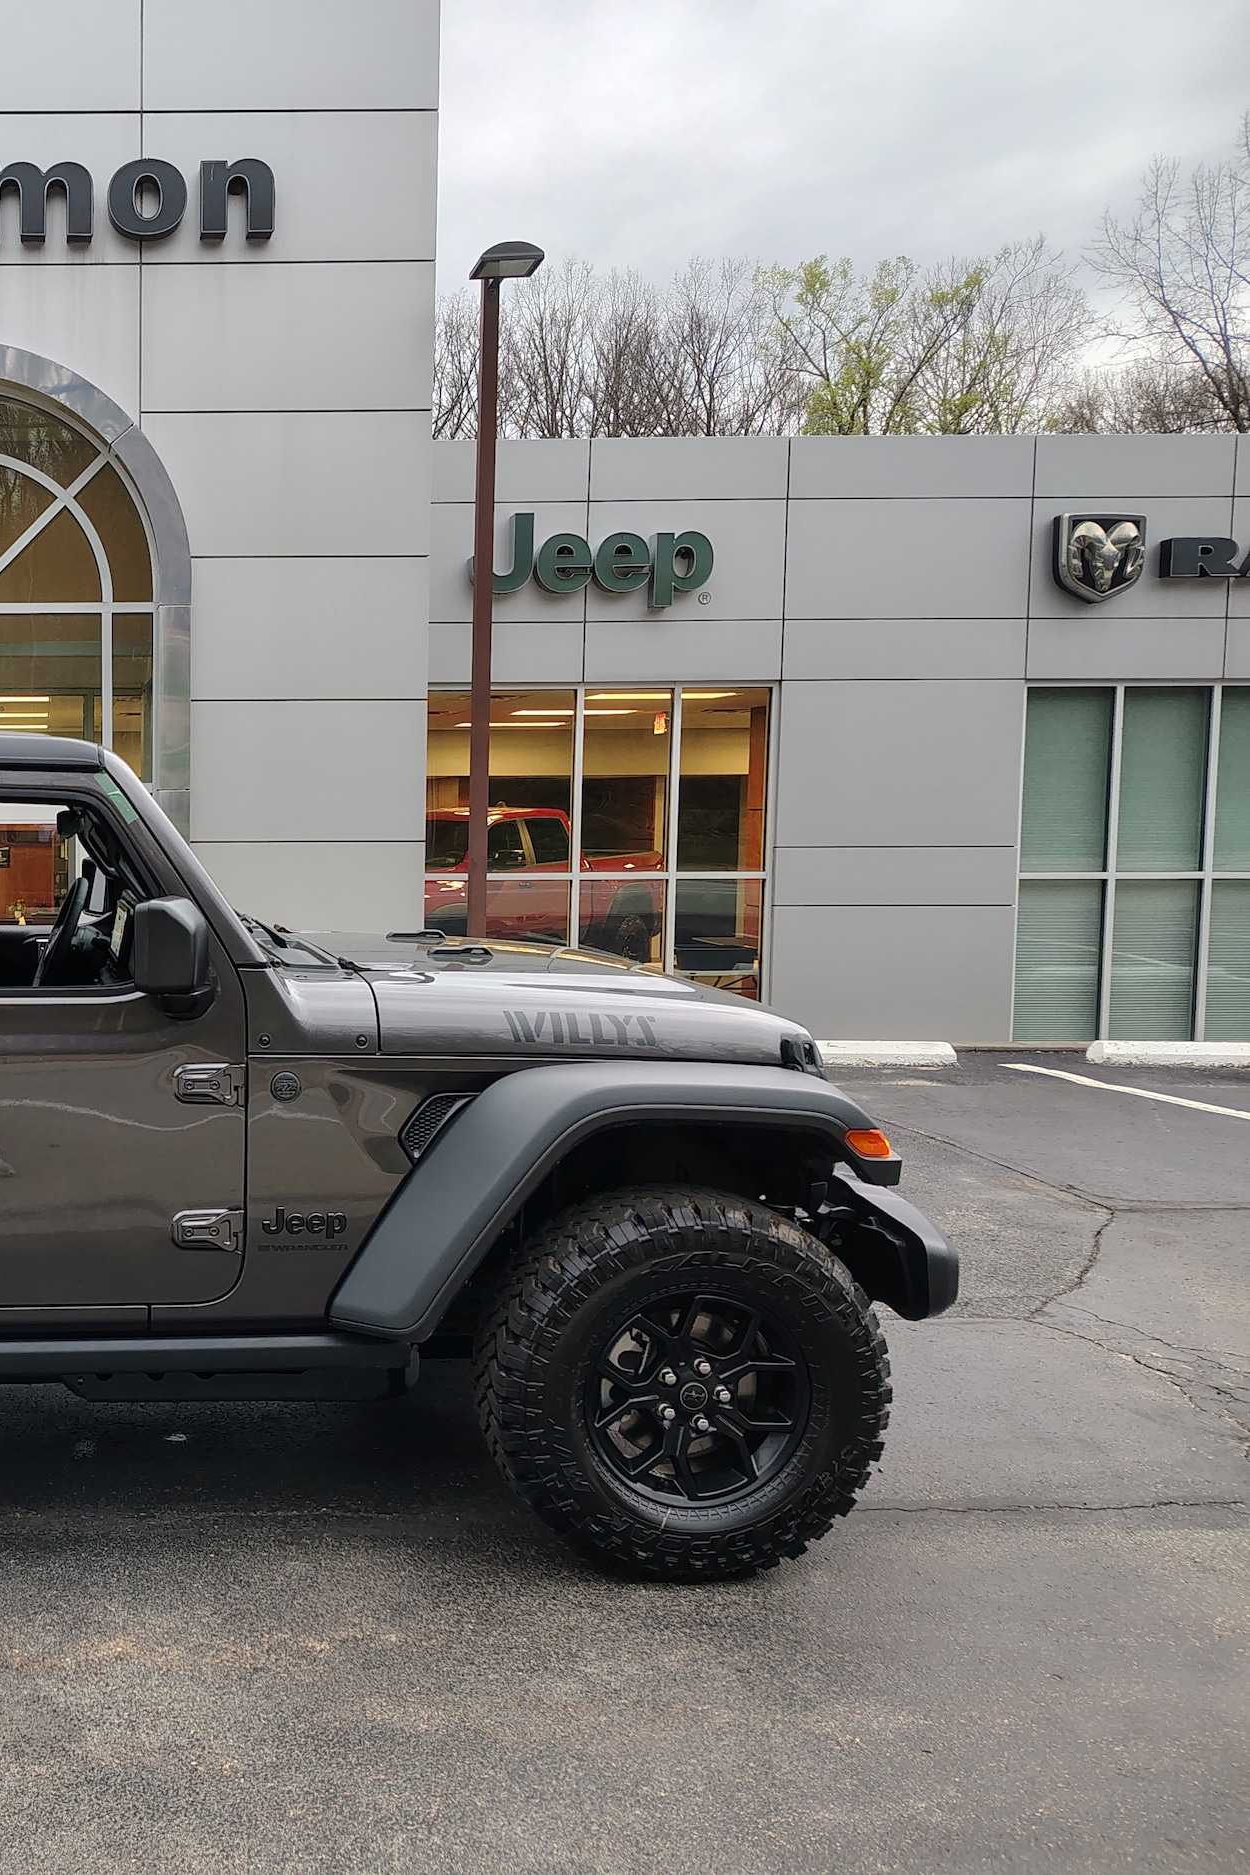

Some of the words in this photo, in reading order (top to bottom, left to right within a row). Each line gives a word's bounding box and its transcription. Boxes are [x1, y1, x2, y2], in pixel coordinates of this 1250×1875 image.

[468, 512, 715, 608] Jeep
[502, 1010, 656, 1046] WILLYS
[261, 1206, 348, 1239] Jeep
